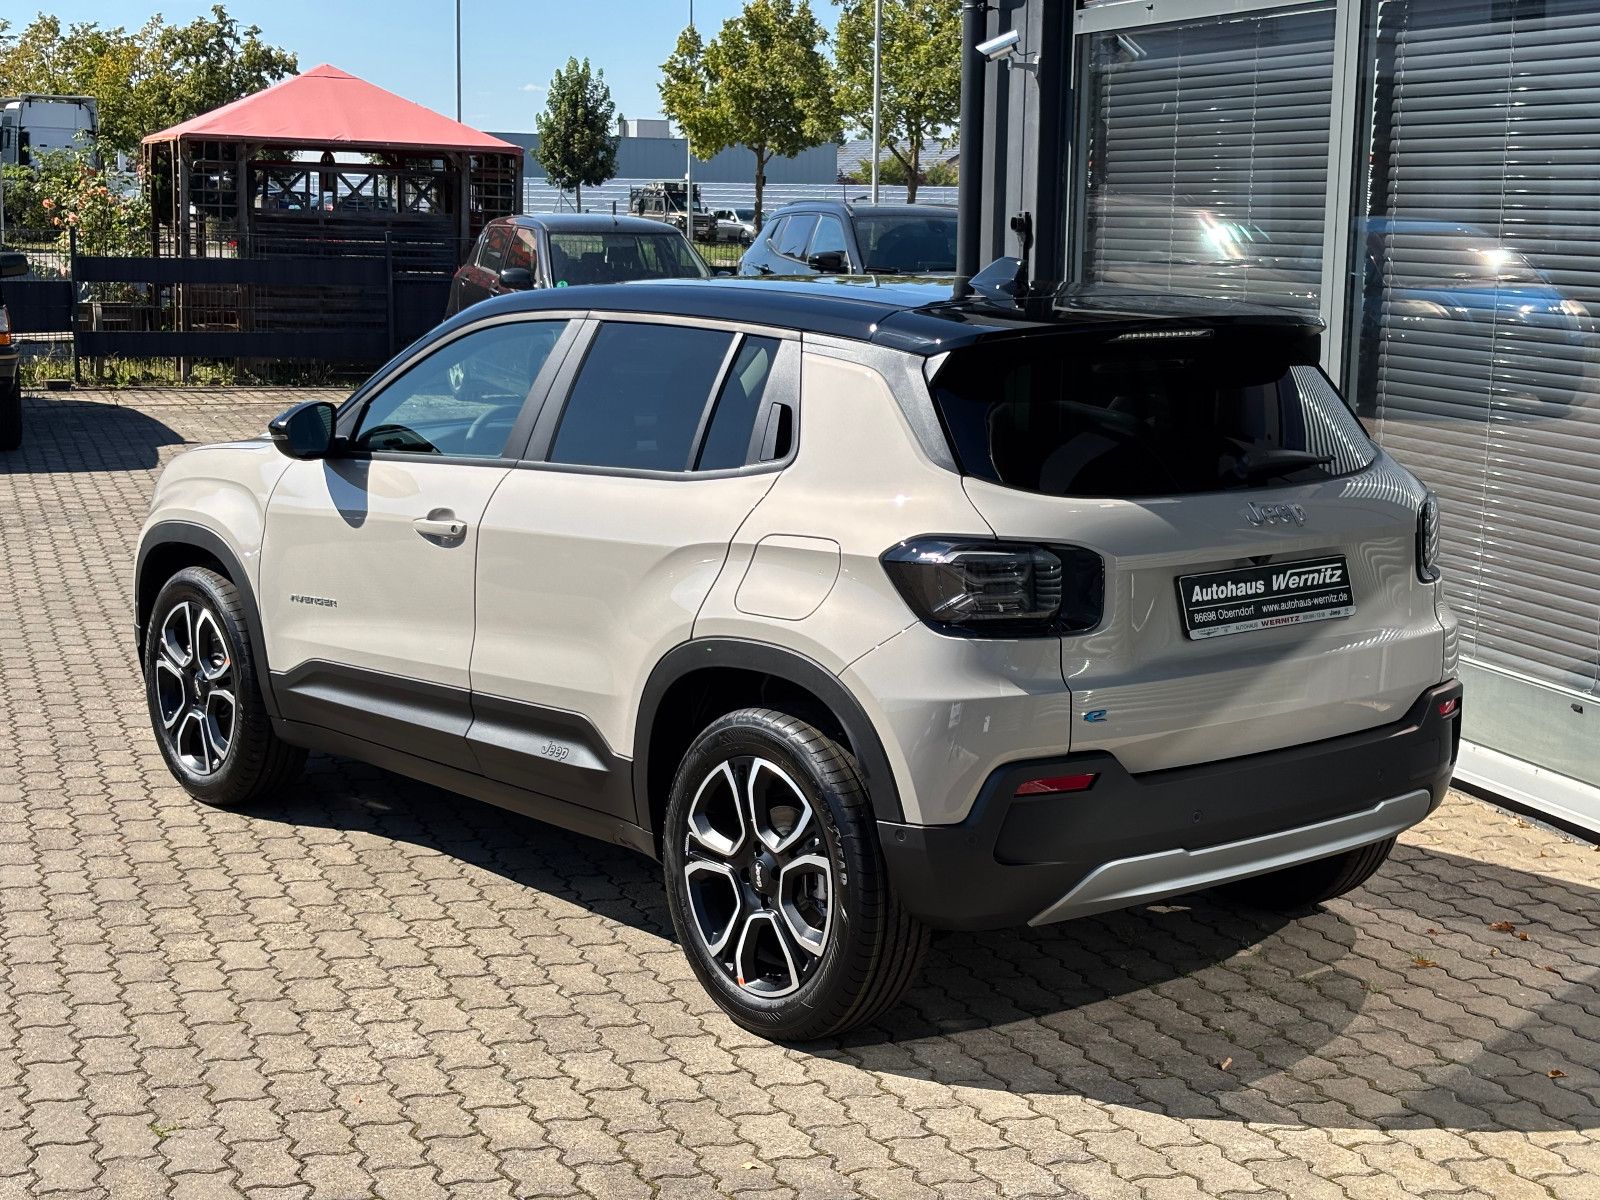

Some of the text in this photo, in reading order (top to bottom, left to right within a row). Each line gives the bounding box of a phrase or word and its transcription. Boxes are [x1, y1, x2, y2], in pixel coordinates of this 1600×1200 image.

[1245, 502, 1307, 527] Jeep
[1191, 565, 1343, 603] Autohaus Wernitz
[1194, 610, 1217, 623] 86698
[1217, 605, 1255, 620] Oberndorf
[1262, 591, 1348, 613] www.autohaus-wernitz.de
[1261, 615, 1300, 627] WERNITZ
[541, 740, 570, 761] Jeep
